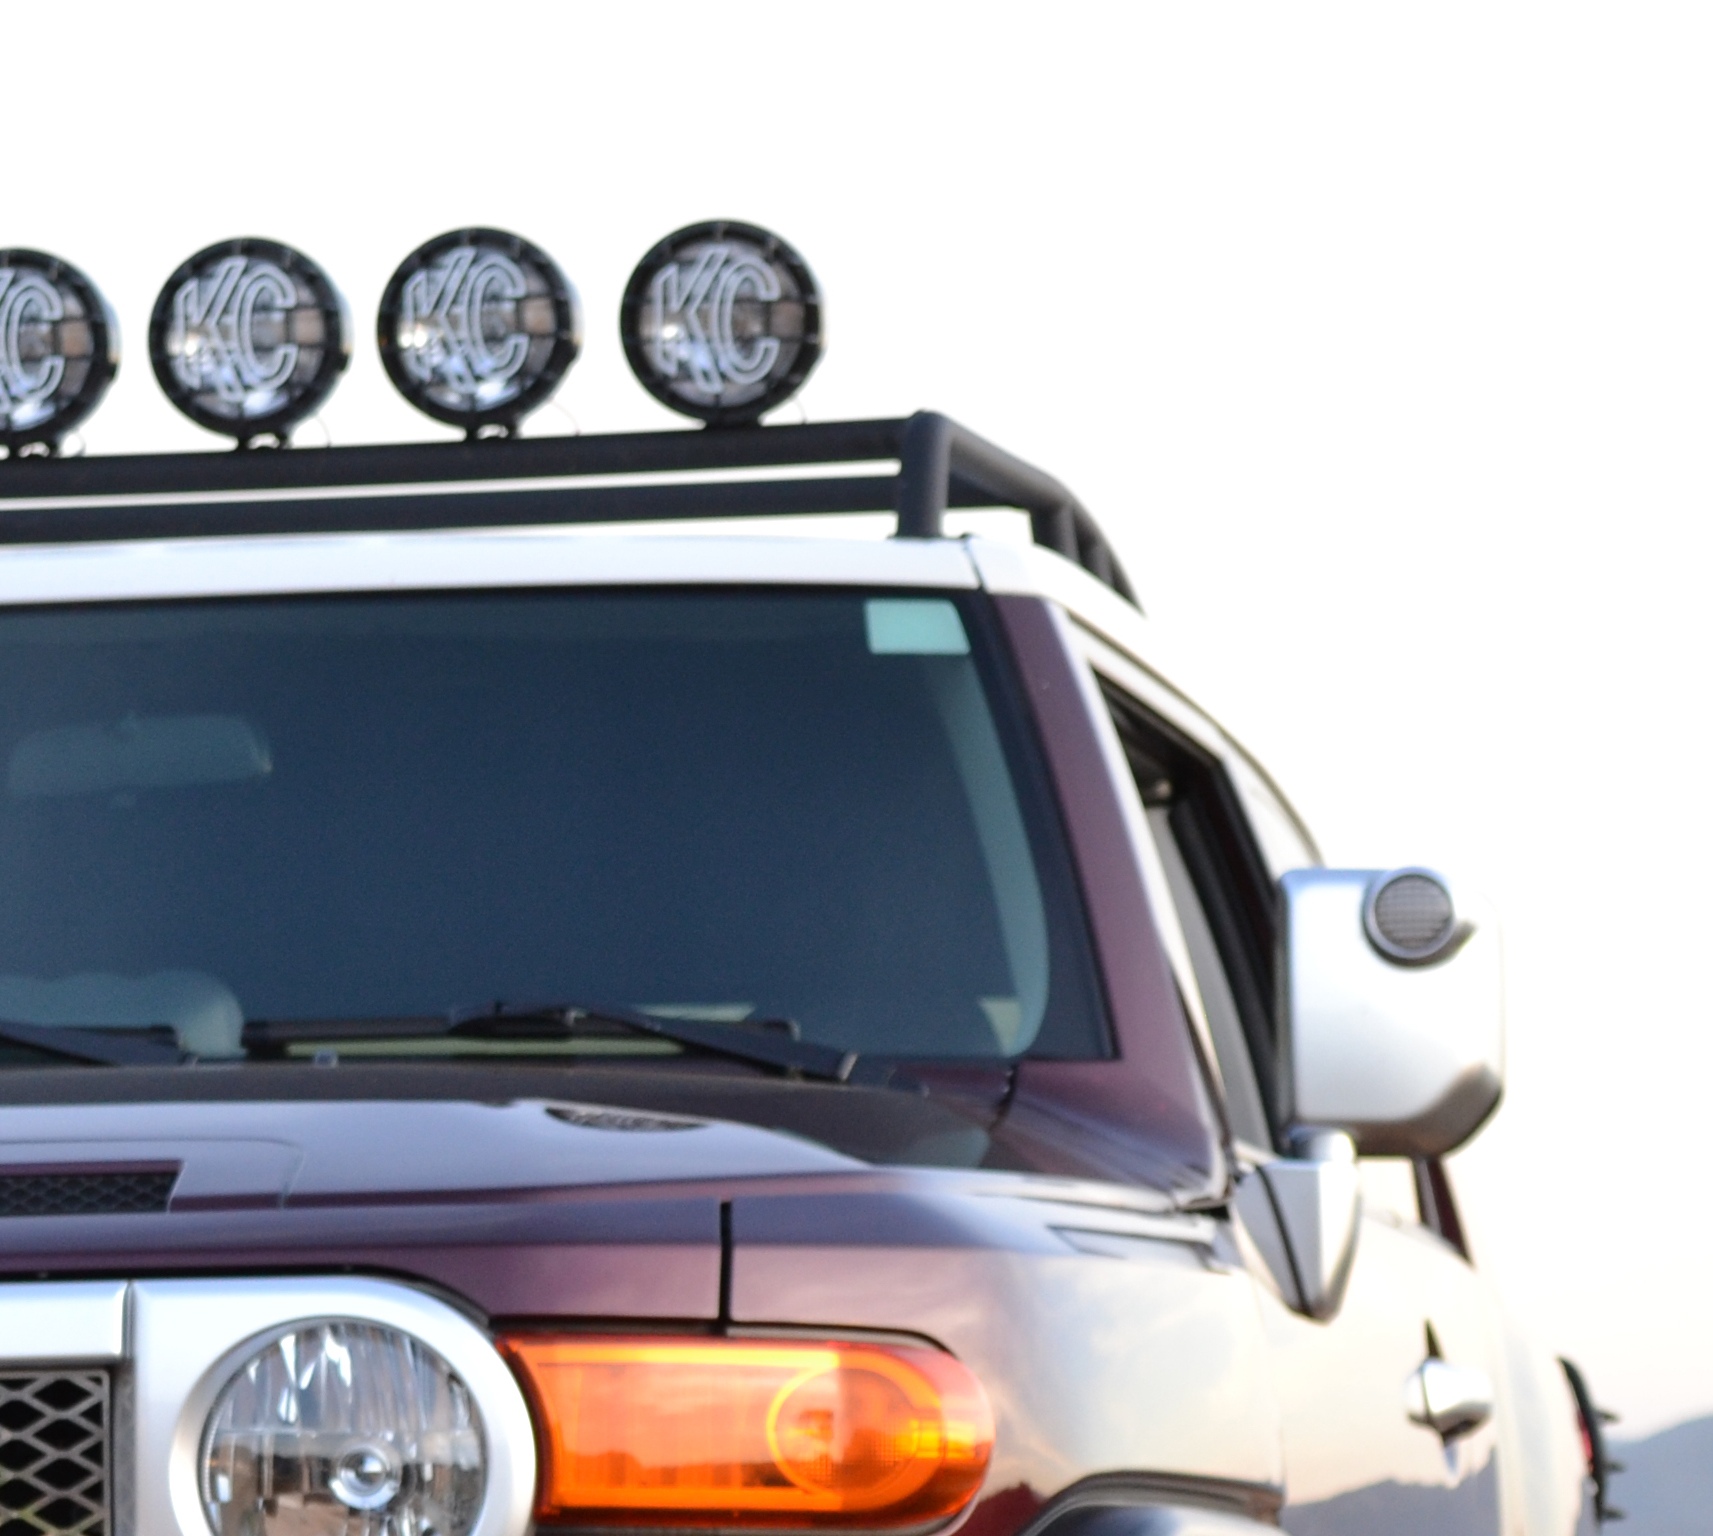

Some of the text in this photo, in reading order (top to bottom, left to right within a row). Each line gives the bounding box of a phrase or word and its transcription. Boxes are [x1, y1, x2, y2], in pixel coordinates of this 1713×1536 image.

[173, 255, 297, 402] KC
[401, 246, 528, 393] KC
[654, 245, 781, 395] KC
